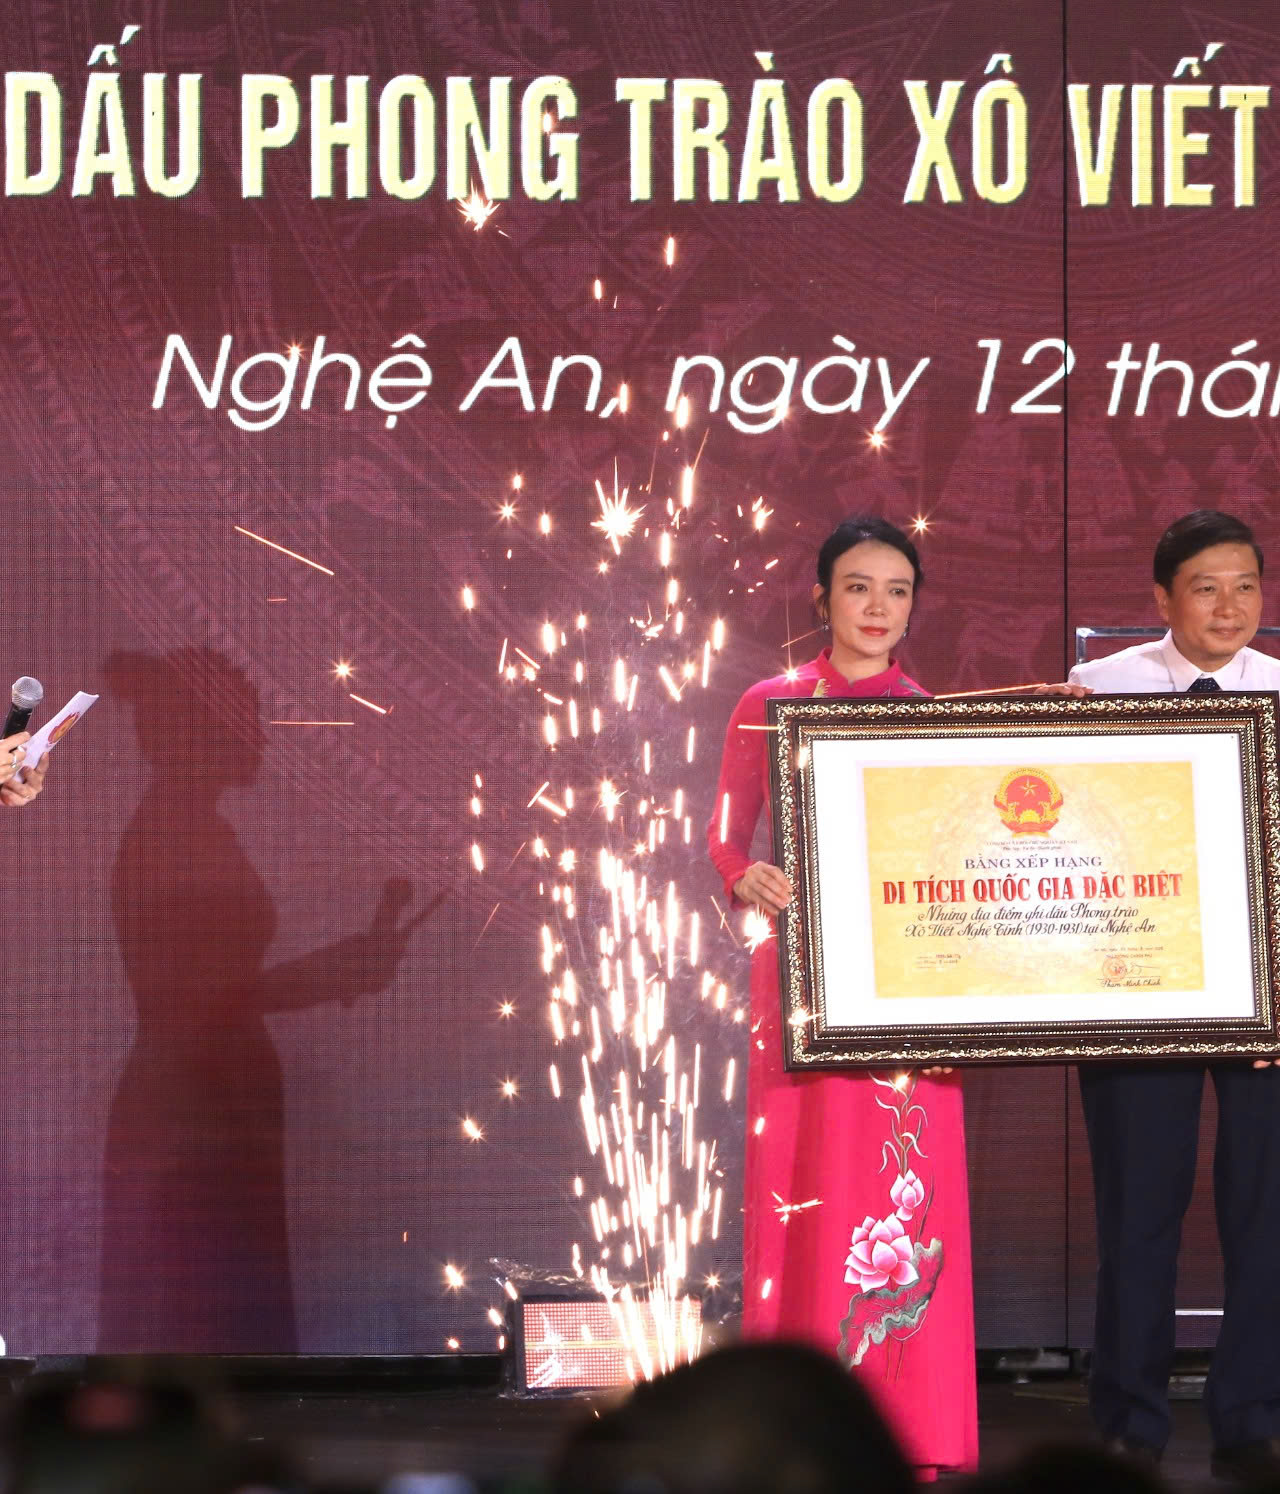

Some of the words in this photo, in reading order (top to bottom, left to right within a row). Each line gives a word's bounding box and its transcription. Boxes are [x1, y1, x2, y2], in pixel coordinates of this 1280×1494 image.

[5, 25, 202, 198] DẤU
[242, 74, 579, 203] PHONG
[616, 51, 863, 204] TRÀO
[904, 53, 1028, 208] XÔ
[1067, 43, 1270, 210] VIẾT
[152, 334, 432, 429] Nghệ
[459, 337, 623, 418] An,
[663, 335, 930, 433] ngày
[976, 338, 1076, 414] 12
[965, 853, 1011, 870] BẢNG
[1016, 853, 1049, 869] XẾP
[1055, 856, 1102, 870] HẠNG
[883, 881, 906, 904] DI
[913, 874, 966, 904] TÍCH
[973, 873, 1031, 903] QUỐC
[1038, 876, 1075, 901] GIA
[1082, 871, 1126, 903] ĐẶC
[1132, 869, 1183, 901] BIỆT
[1022, 904, 1045, 923] ghi
[1071, 902, 1111, 921] Phong
[1135, 918, 1157, 933] An
